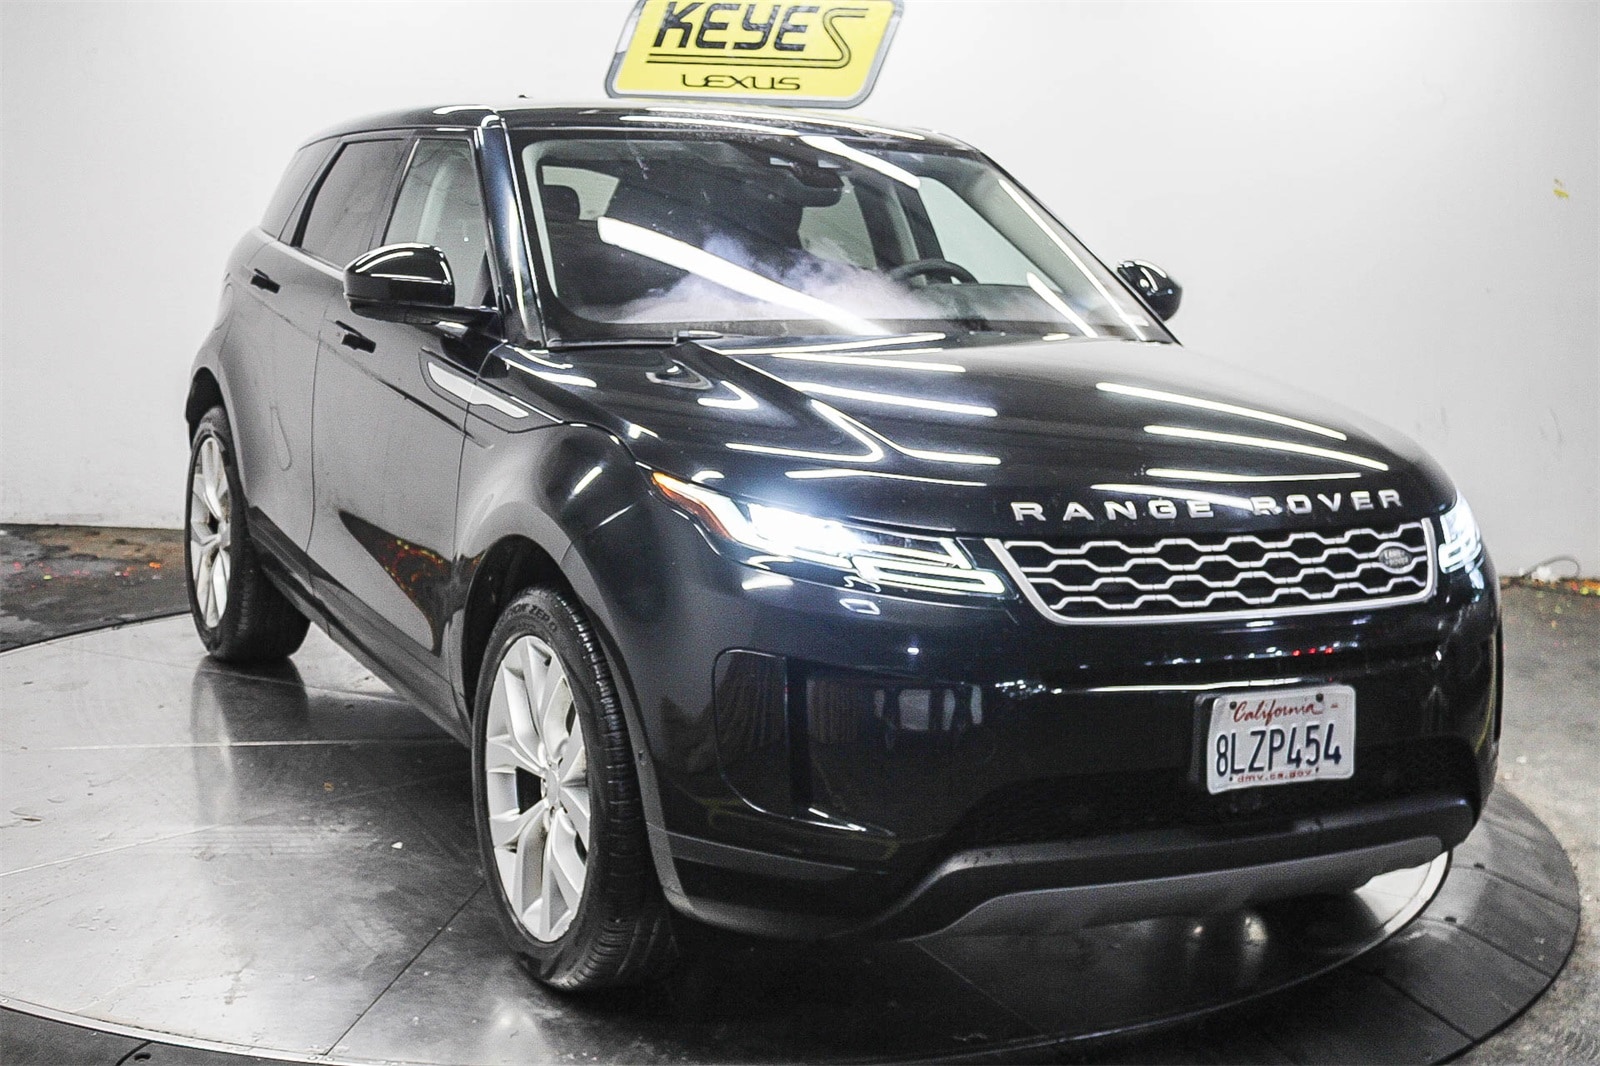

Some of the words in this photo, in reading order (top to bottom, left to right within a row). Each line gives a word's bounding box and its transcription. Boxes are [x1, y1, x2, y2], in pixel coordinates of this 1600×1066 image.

[652, 1, 869, 68] KEYES
[682, 74, 800, 90] LEXUS
[1010, 499, 1214, 521] RANGE
[1252, 489, 1402, 516] ROVER
[1233, 699, 1323, 726] California
[1216, 723, 1341, 776] 8LZP454
